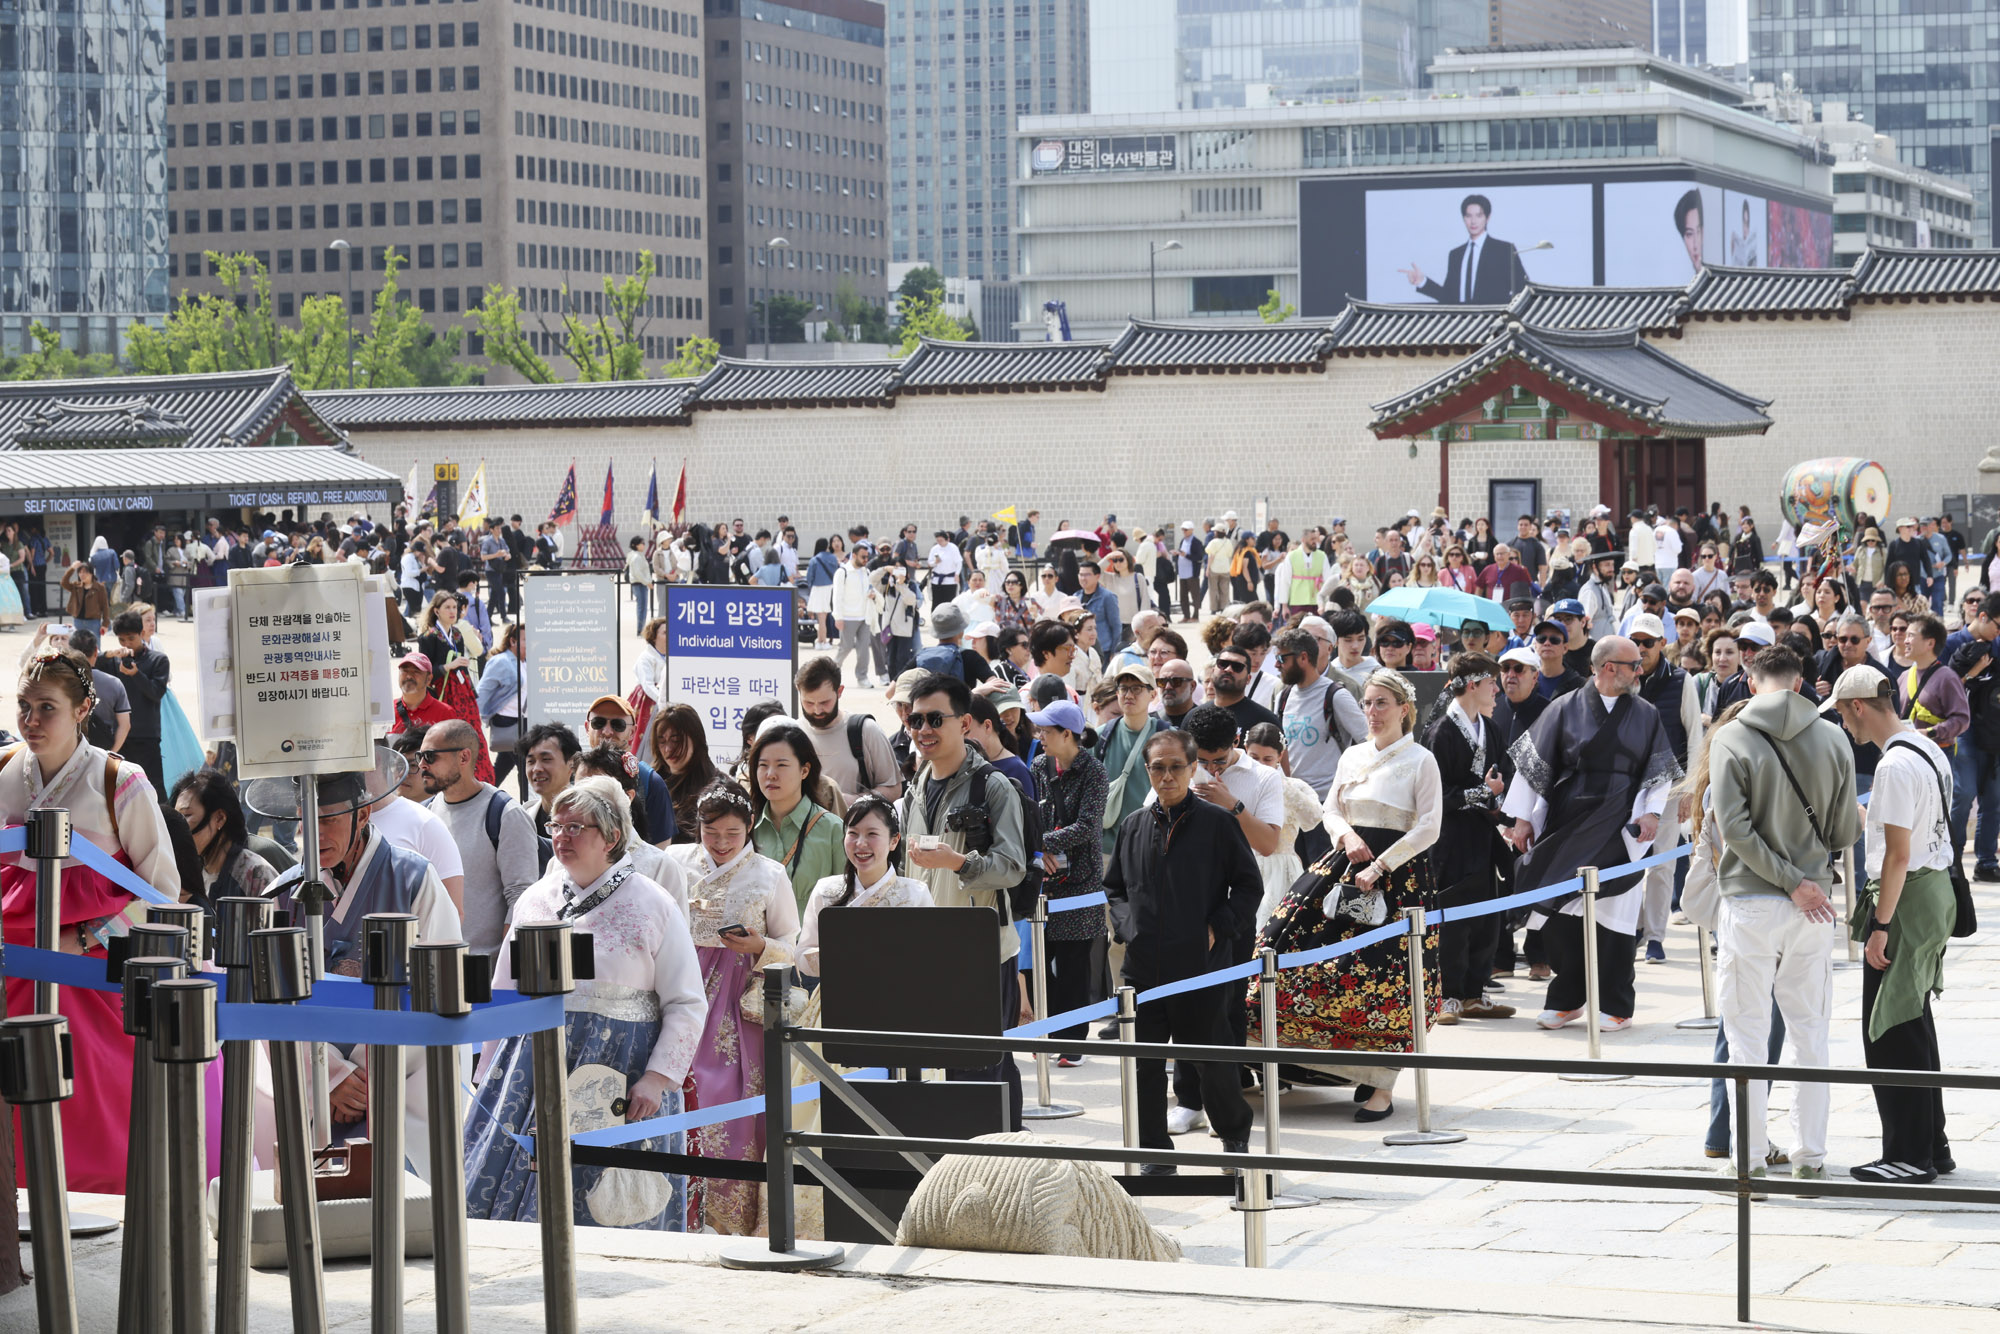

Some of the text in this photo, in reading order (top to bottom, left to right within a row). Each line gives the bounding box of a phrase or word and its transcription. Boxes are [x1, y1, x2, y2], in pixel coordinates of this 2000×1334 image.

[1069, 140, 1094, 154] 대한
[1069, 154, 1094, 169] 민국
[1100, 150, 1173, 167] 역사박물관
[24, 496, 153, 513] SELF TICKETING (ONLY CARD)
[228, 493, 256, 506] TICKET
[323, 490, 343, 503] FREE
[344, 489, 388, 503] ADMISSION)
[249, 612, 351, 627] 단체 관람객을 인솔하는
[677, 600, 783, 627] 개인 입장객
[261, 630, 341, 645] 문화관광해설사 및
[678, 634, 783, 649] Individual Visitors
[263, 650, 341, 664] 관광통역안내사는
[246, 671, 276, 684] 반드시
[280, 669, 319, 682] 자격증을
[681, 676, 779, 697] 파란선을 따라
[257, 687, 351, 702] 입장하시기 바랍니다.
[716, 754, 731, 764] the
